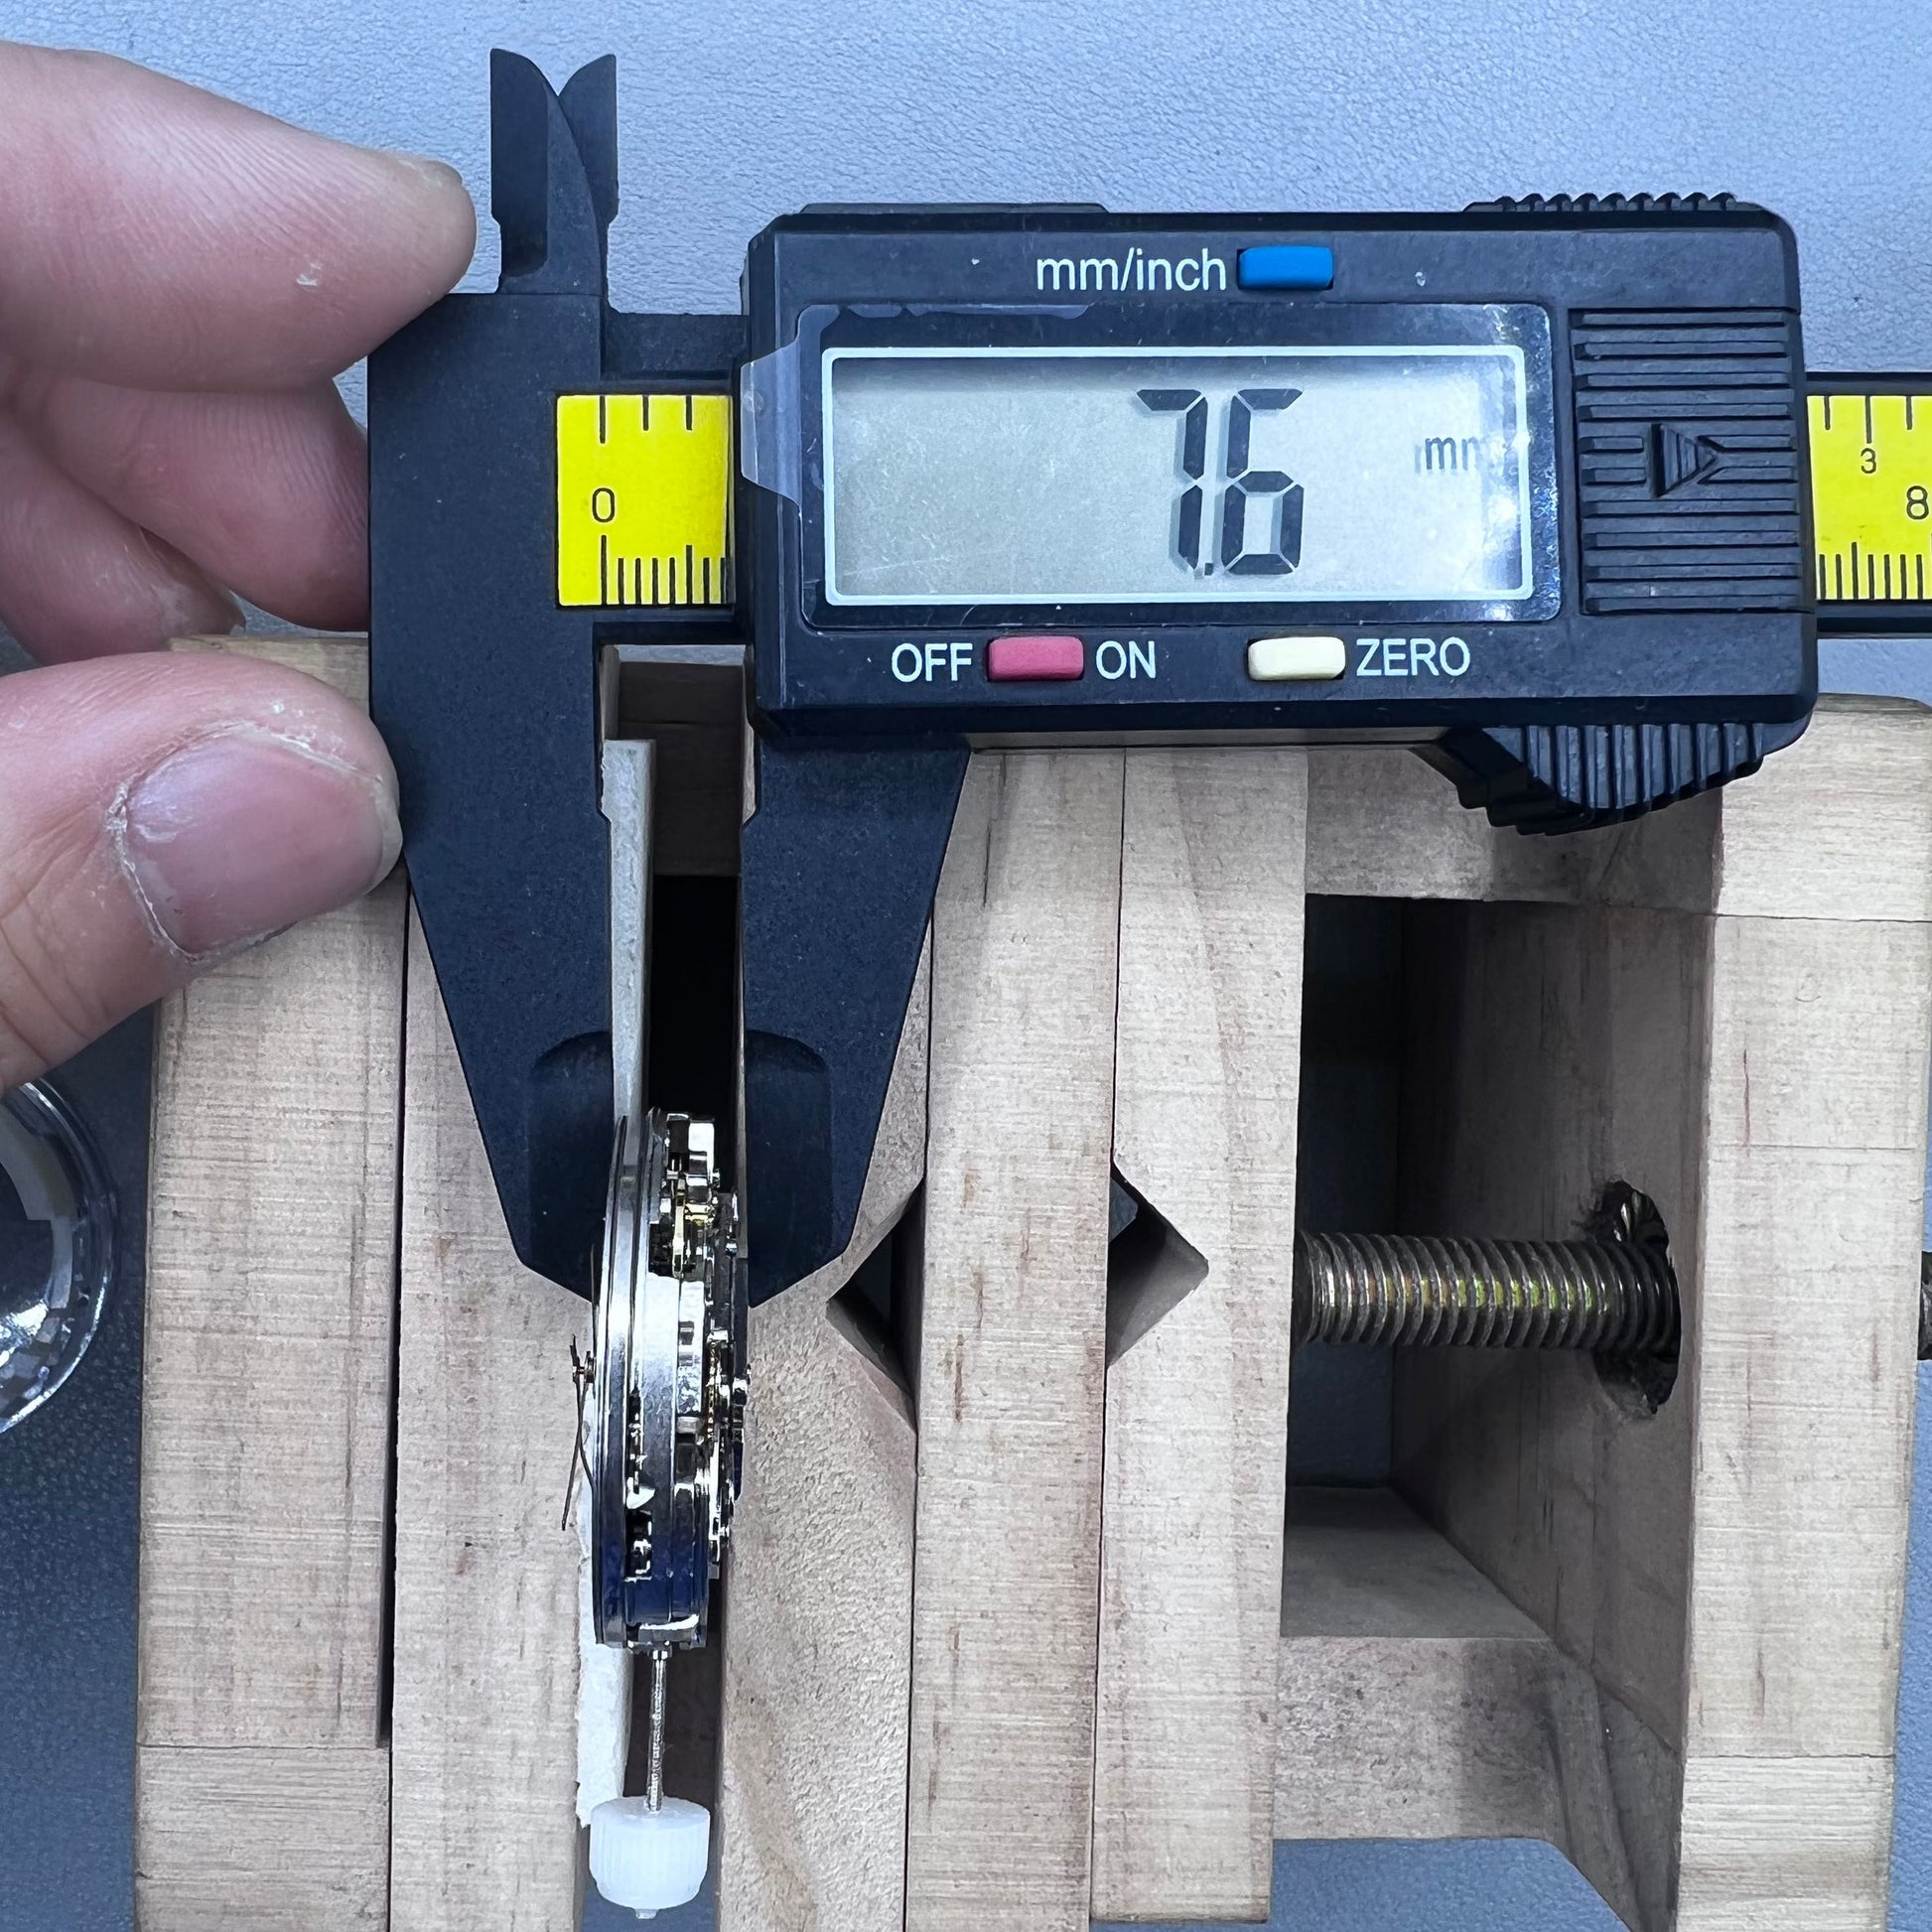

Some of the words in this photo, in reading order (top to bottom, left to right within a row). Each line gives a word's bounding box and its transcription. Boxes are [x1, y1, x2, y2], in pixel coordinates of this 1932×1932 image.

[1036, 247, 1226, 291] mm/inch
[1861, 448, 1877, 475] 3
[1136, 388, 1305, 576] 7.6
[1906, 485, 1929, 519] 8
[592, 487, 616, 523] 0
[892, 642, 973, 682] OFF
[1095, 640, 1157, 680] ON
[1356, 636, 1470, 676] ZERO
